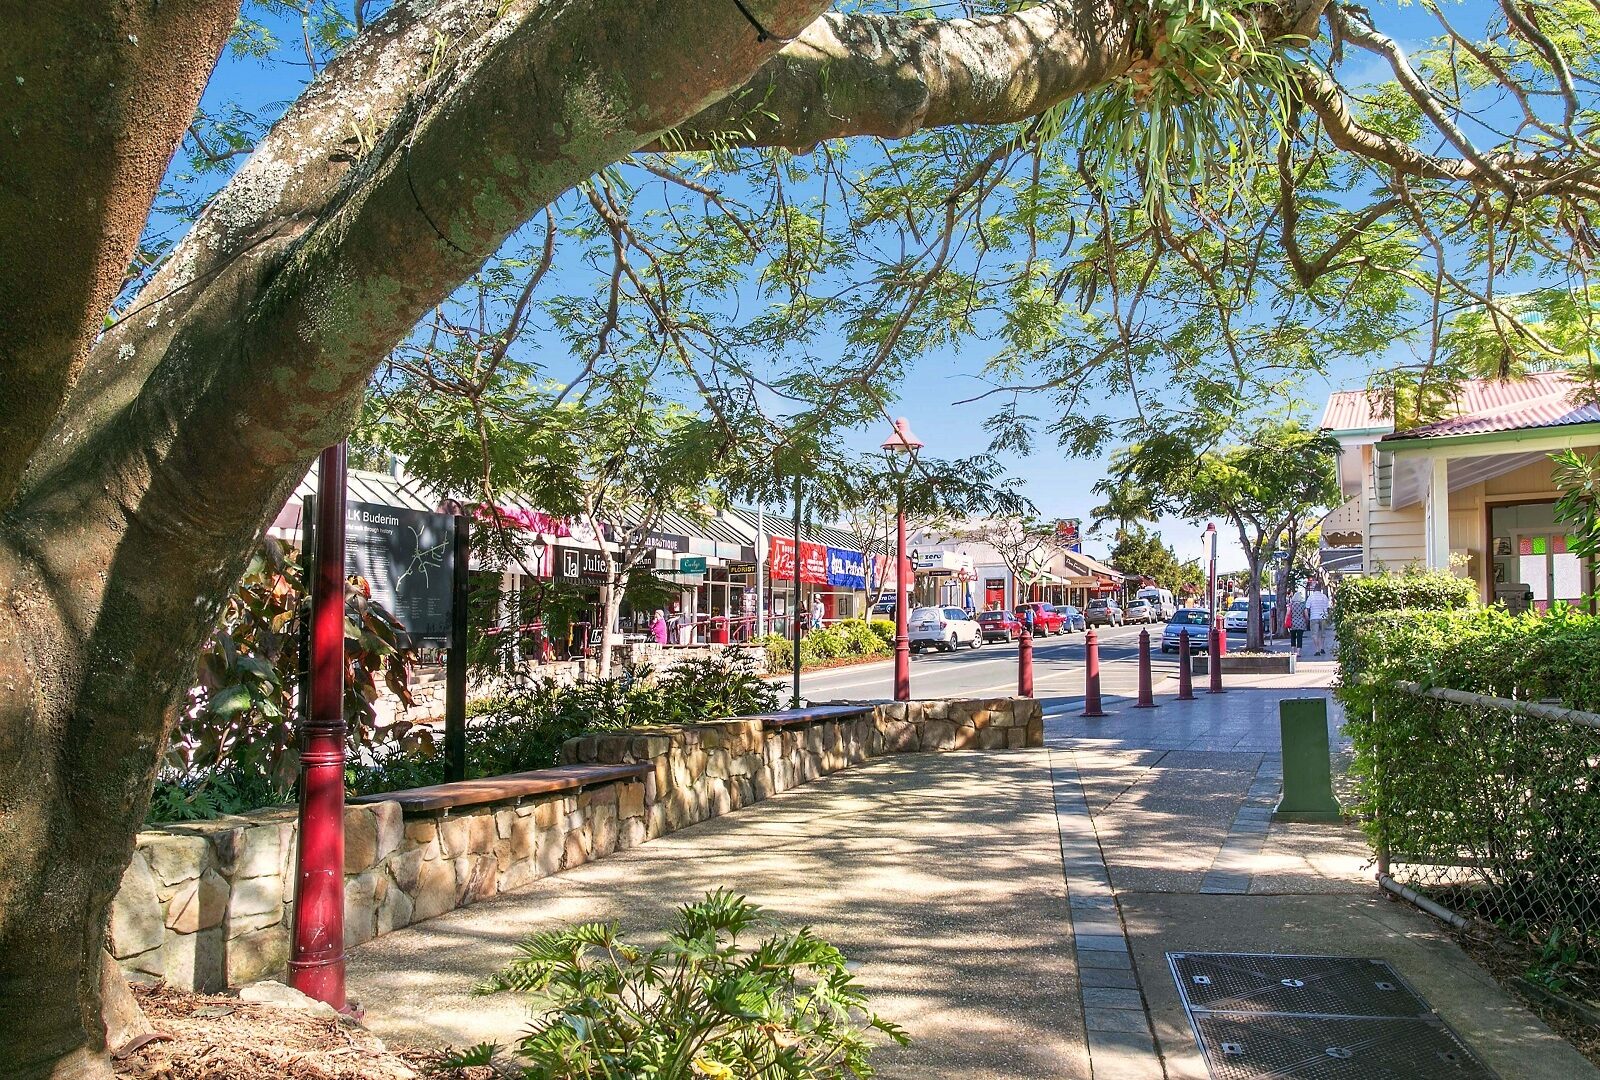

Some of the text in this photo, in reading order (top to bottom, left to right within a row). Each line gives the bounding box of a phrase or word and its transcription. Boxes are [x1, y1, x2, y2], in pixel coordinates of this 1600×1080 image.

[345, 509, 399, 526] LK Buderim
[380, 527, 393, 536] history
[730, 565, 756, 573] FLORIST
